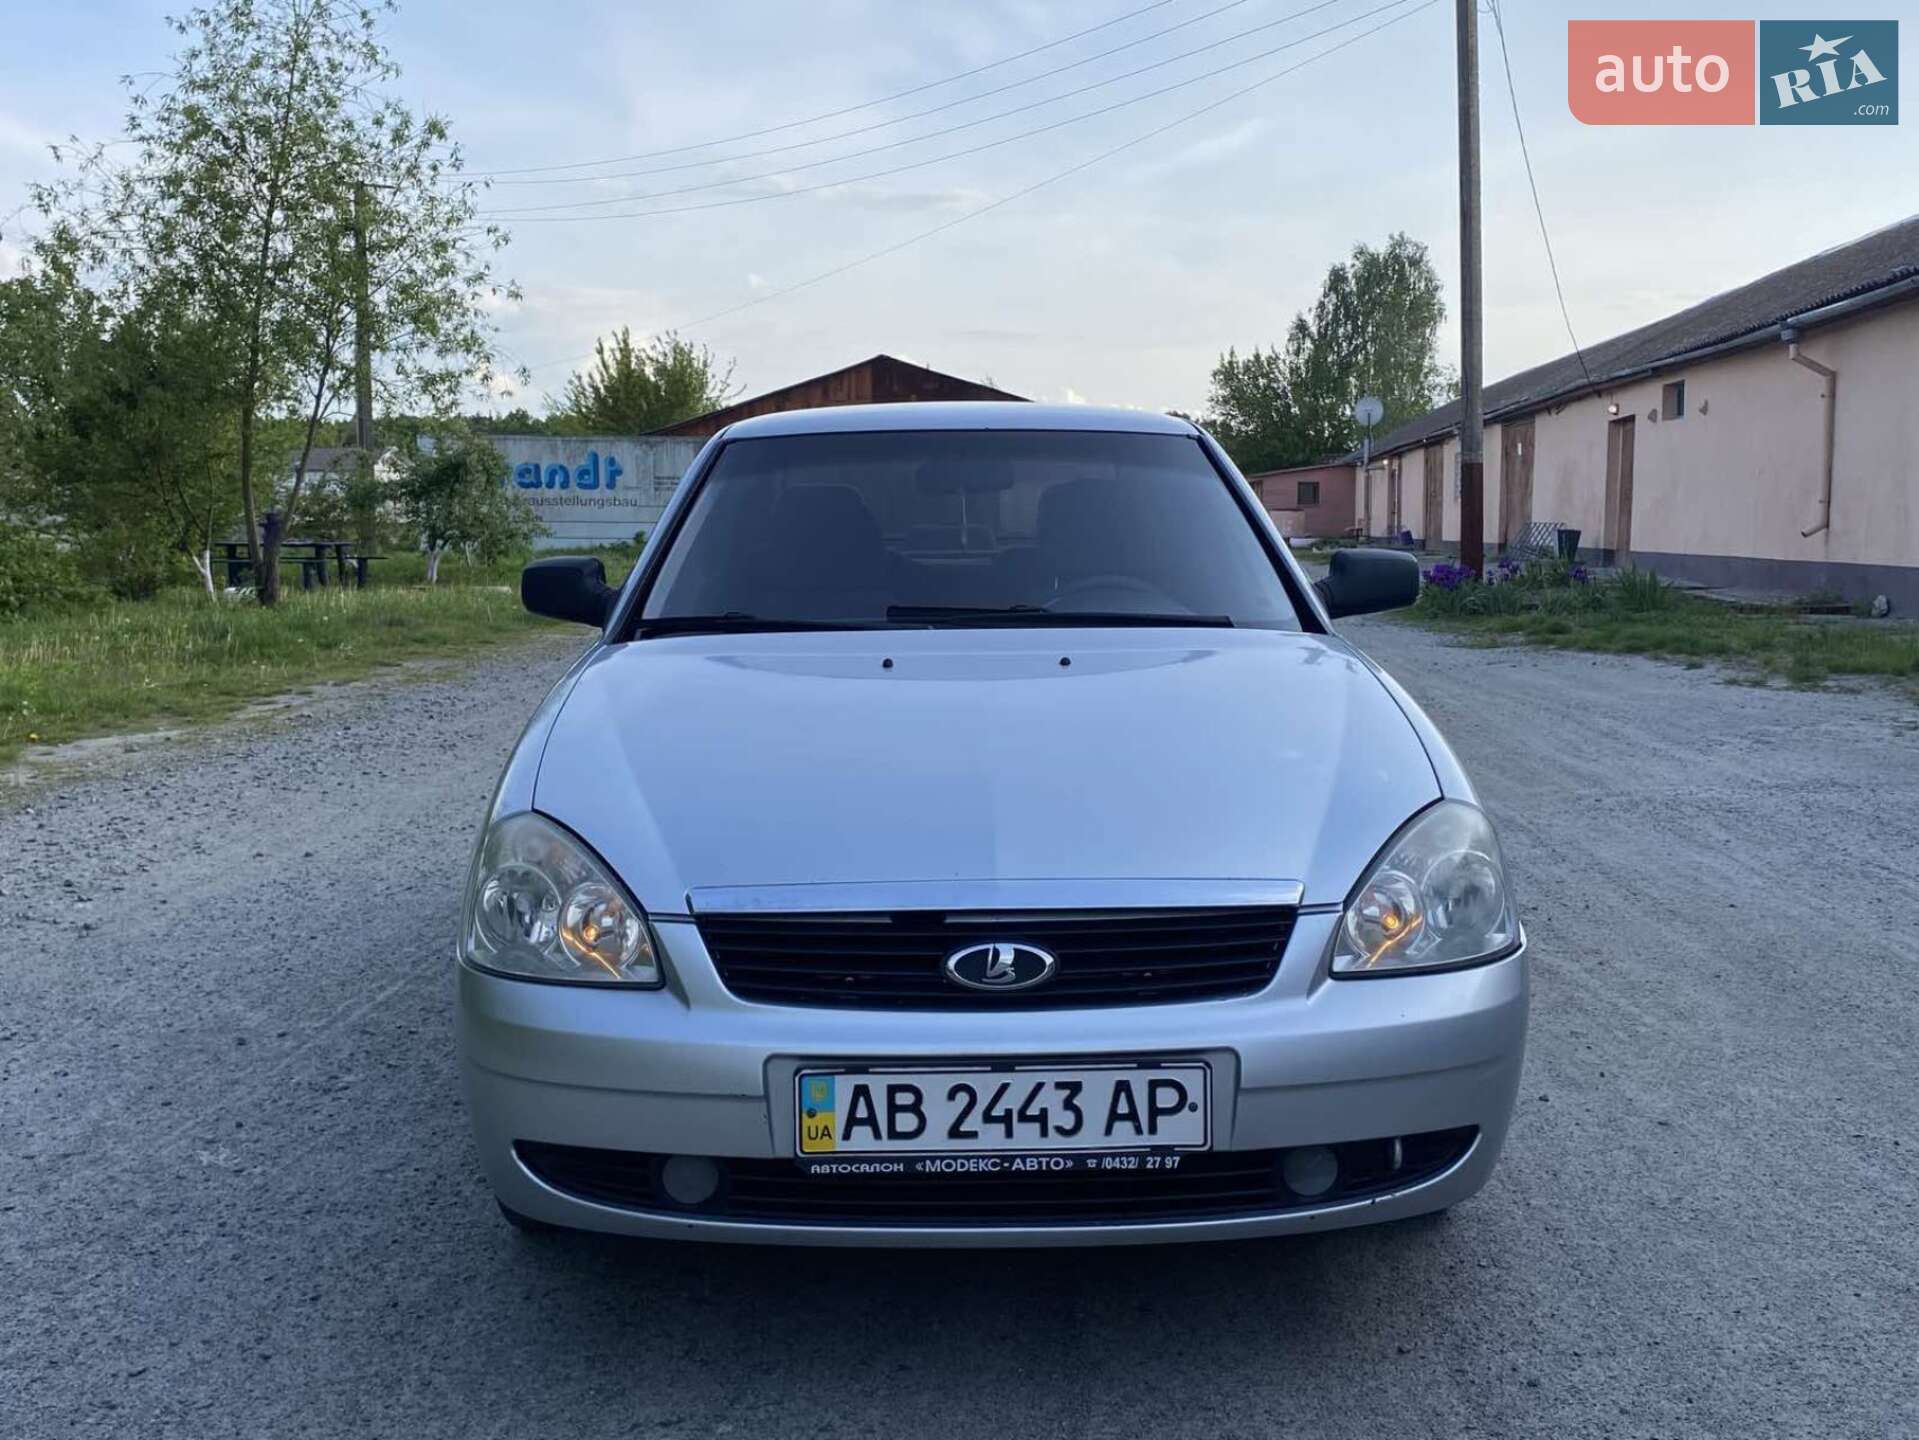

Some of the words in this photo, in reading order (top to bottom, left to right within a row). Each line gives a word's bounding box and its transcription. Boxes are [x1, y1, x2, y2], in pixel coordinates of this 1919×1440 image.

[513, 450, 623, 489] andt
[842, 1083, 927, 1141] AB
[946, 1080, 1084, 1139] 2443
[1104, 1078, 1188, 1136] AP
[807, 1127, 832, 1141] UA
